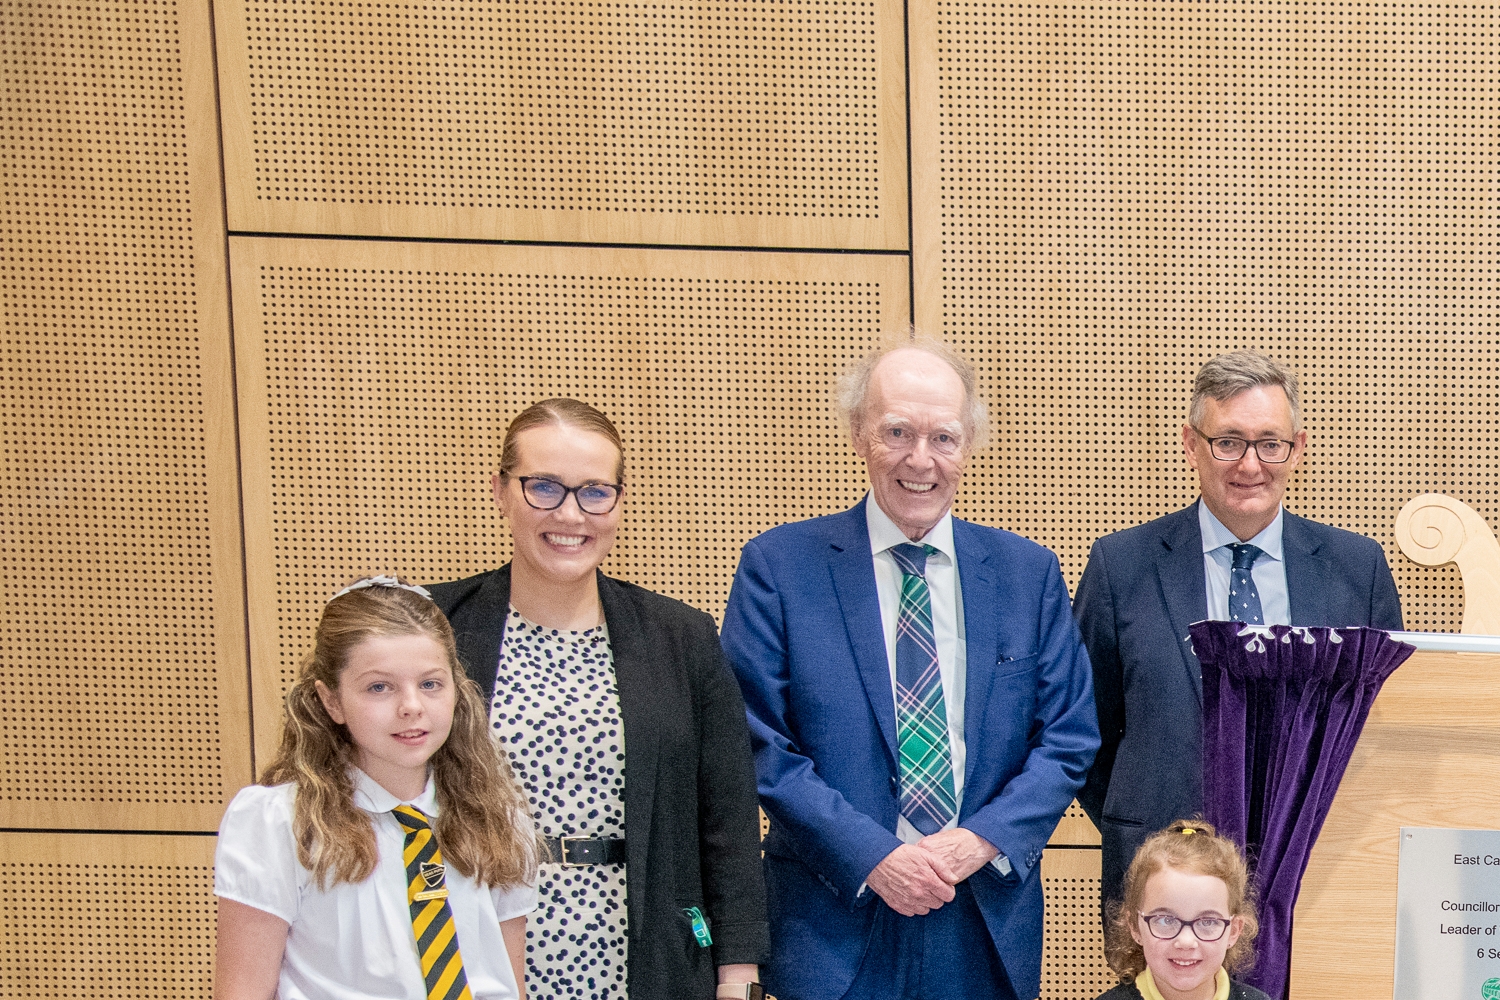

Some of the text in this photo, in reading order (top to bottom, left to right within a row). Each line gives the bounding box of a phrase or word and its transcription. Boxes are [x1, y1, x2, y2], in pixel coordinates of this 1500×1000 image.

[1454, 854, 1480, 865] East
[1441, 900, 1500, 912] Councillor
[1440, 923, 1482, 935] Leader
[1484, 925, 1497, 936] of
[1476, 948, 1485, 959] 6
